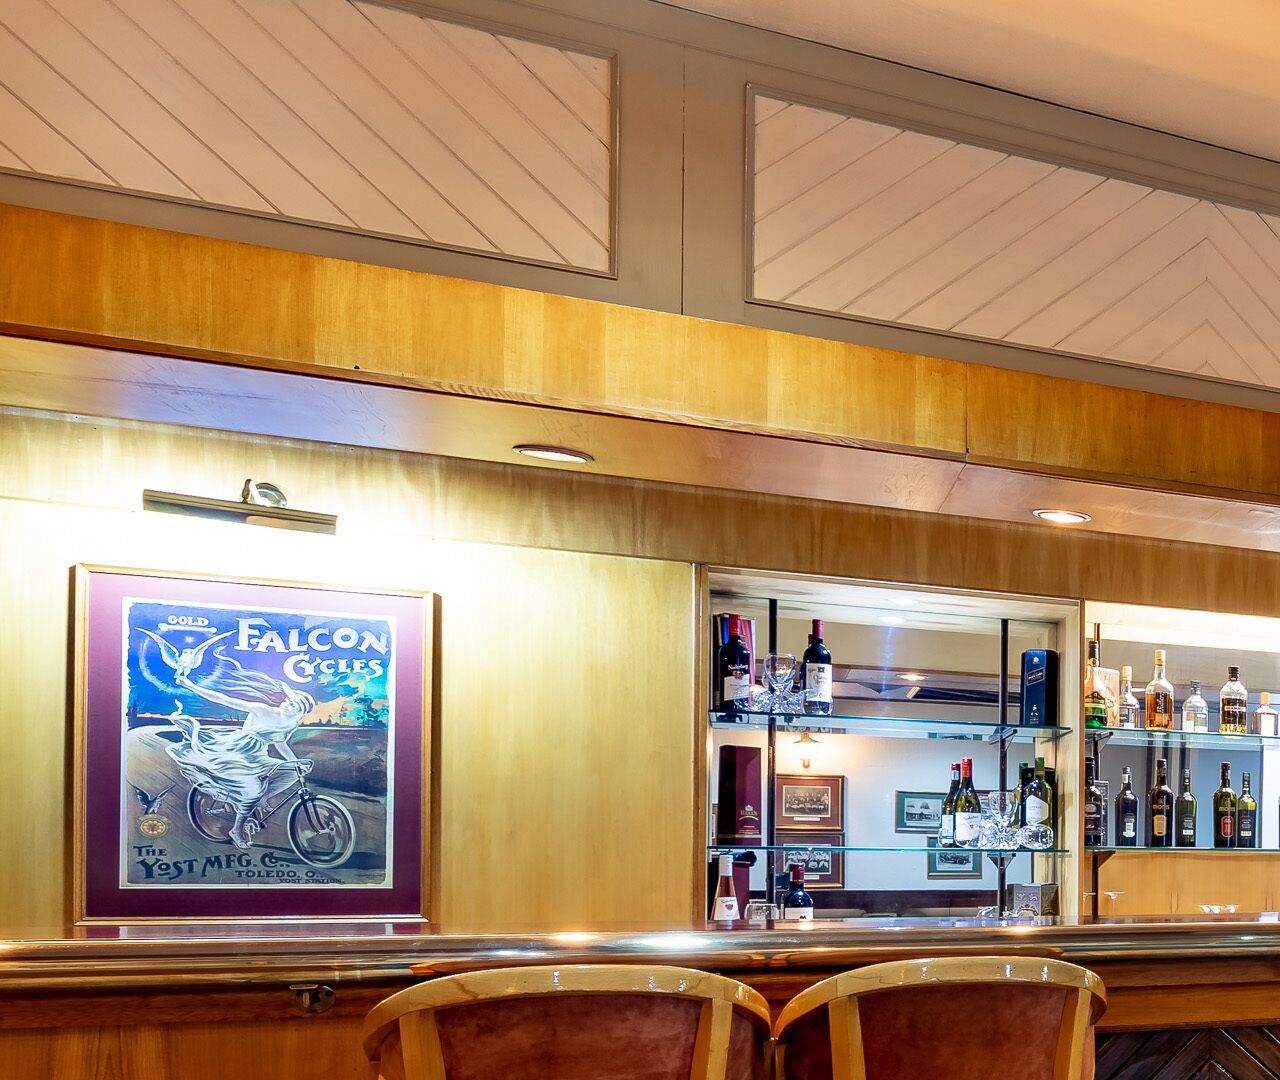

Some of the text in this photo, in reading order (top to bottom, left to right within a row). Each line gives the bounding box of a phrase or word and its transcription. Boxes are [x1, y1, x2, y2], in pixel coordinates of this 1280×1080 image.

[167, 615, 209, 626] GOLD
[234, 618, 390, 655] FALCON
[283, 652, 384, 683] CYCLES
[133, 845, 167, 857] THE
[136, 858, 198, 881] YOST
